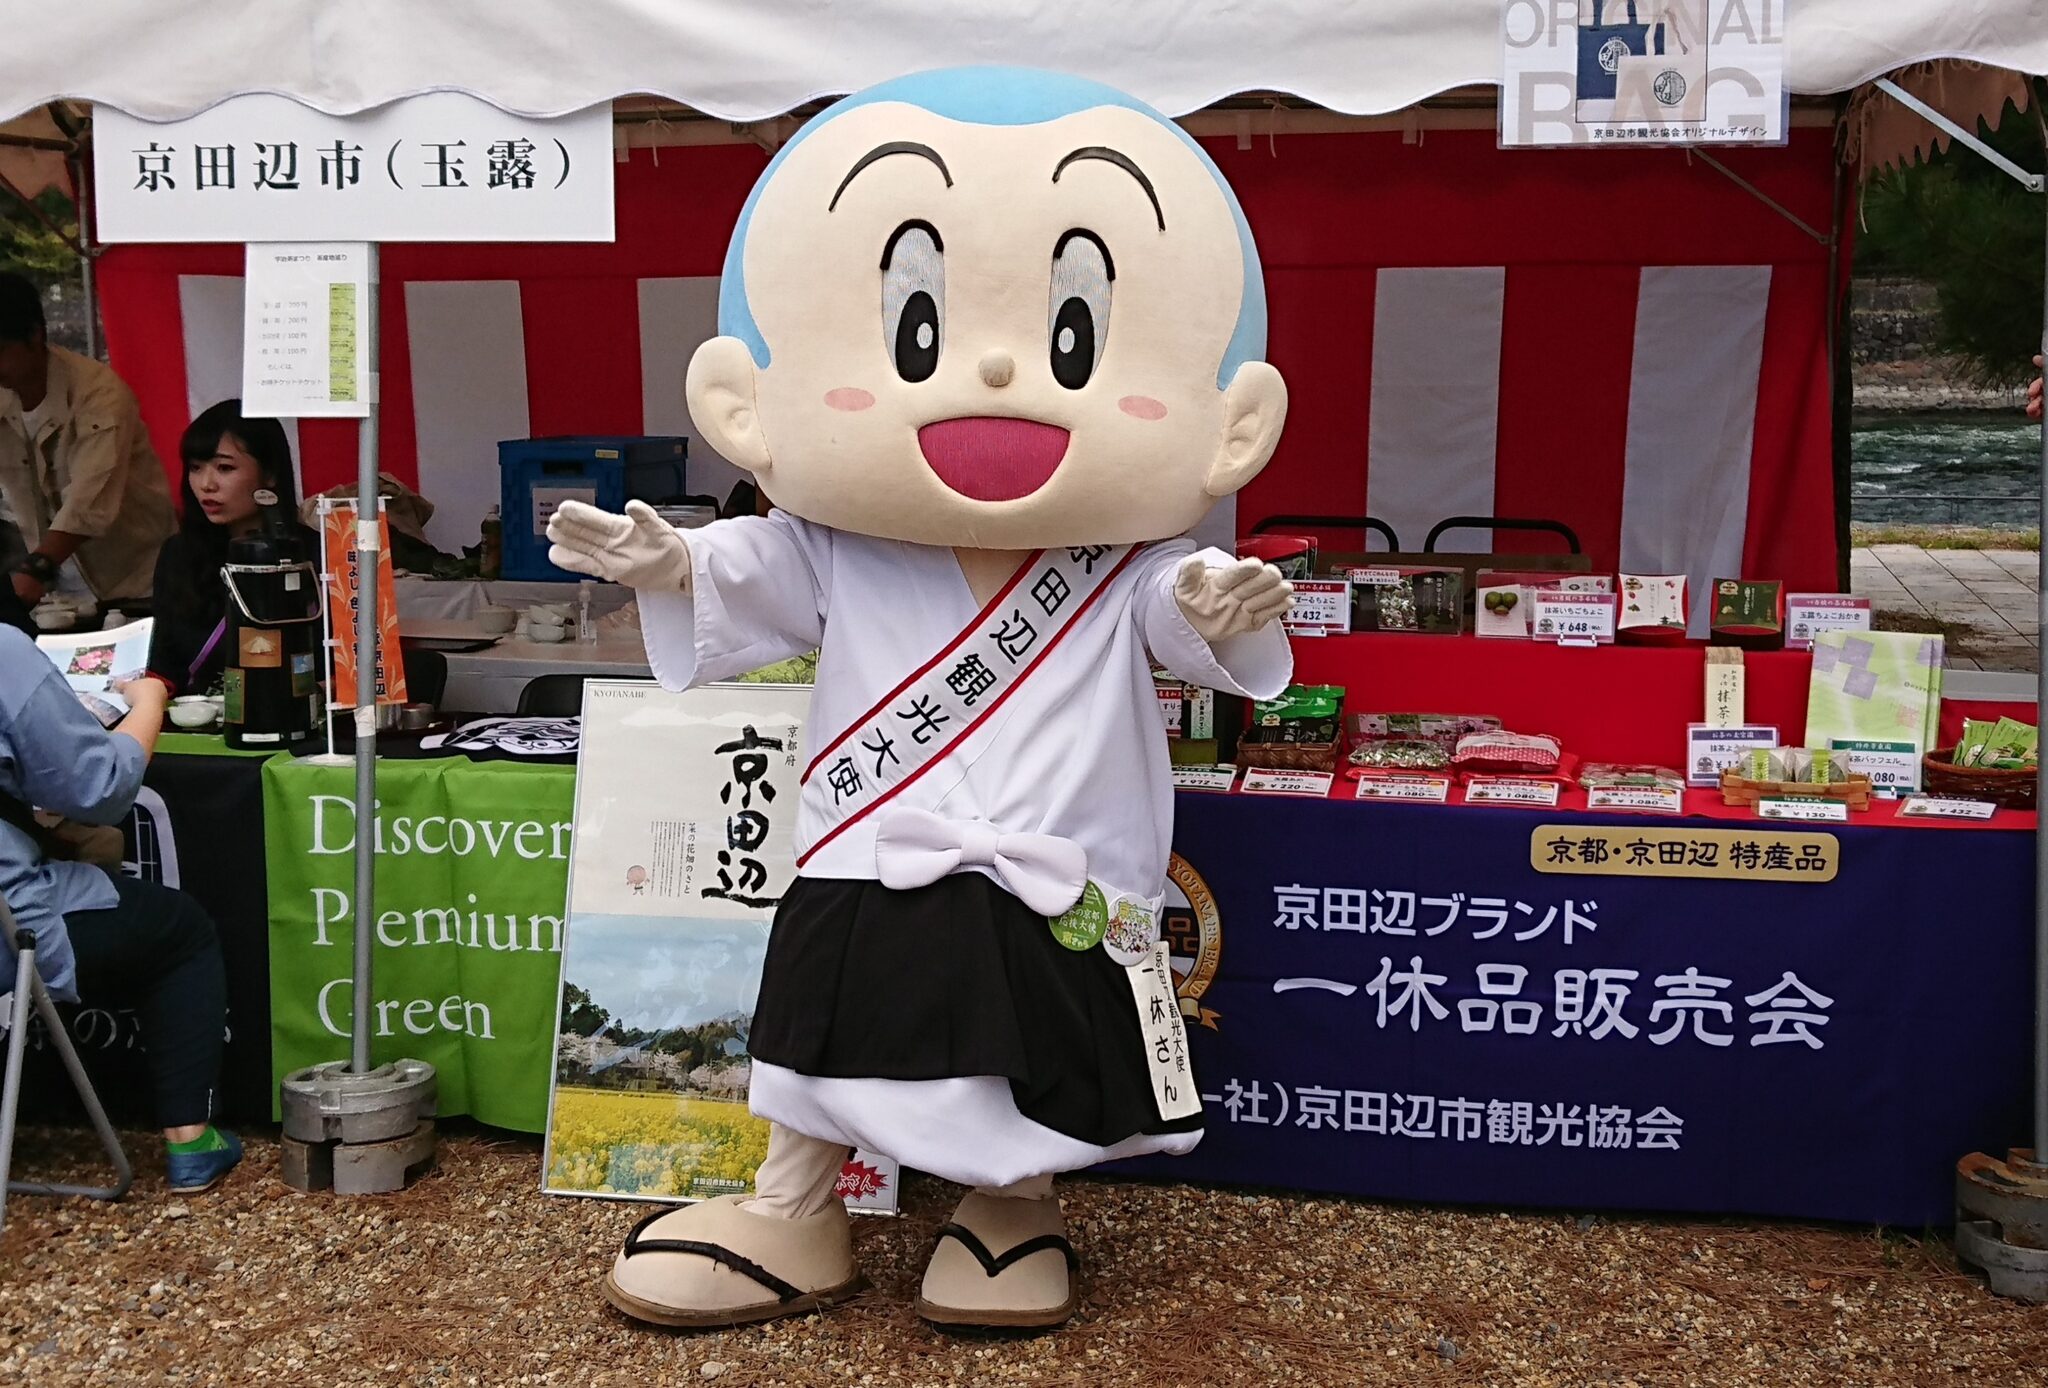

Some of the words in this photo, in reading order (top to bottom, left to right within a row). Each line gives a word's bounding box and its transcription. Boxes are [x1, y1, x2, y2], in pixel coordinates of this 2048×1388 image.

[1593, 127, 1767, 138] 京田辺市観光協会オリジナルデザイン
[1295, 596, 1335, 604] ぼーるちょこ
[1302, 610, 1321, 620] 432
[1568, 622, 1588, 632] 648
[594, 690, 647, 698] KYOTANABE
[784, 725, 799, 767] 京都府
[308, 795, 573, 861] Discover
[701, 724, 784, 908] 京田辺
[1546, 836, 1719, 868] 京都・京田辺
[1729, 841, 1828, 872] 特産品
[312, 888, 564, 953] Pemium
[1173, 862, 1217, 944] YOTANABE
[1273, 883, 1599, 945] 京田辺ブランド
[318, 979, 495, 1040] Green
[1273, 955, 1835, 1050] 一休品販売会
[1142, 968, 1177, 1104] 一休さん
